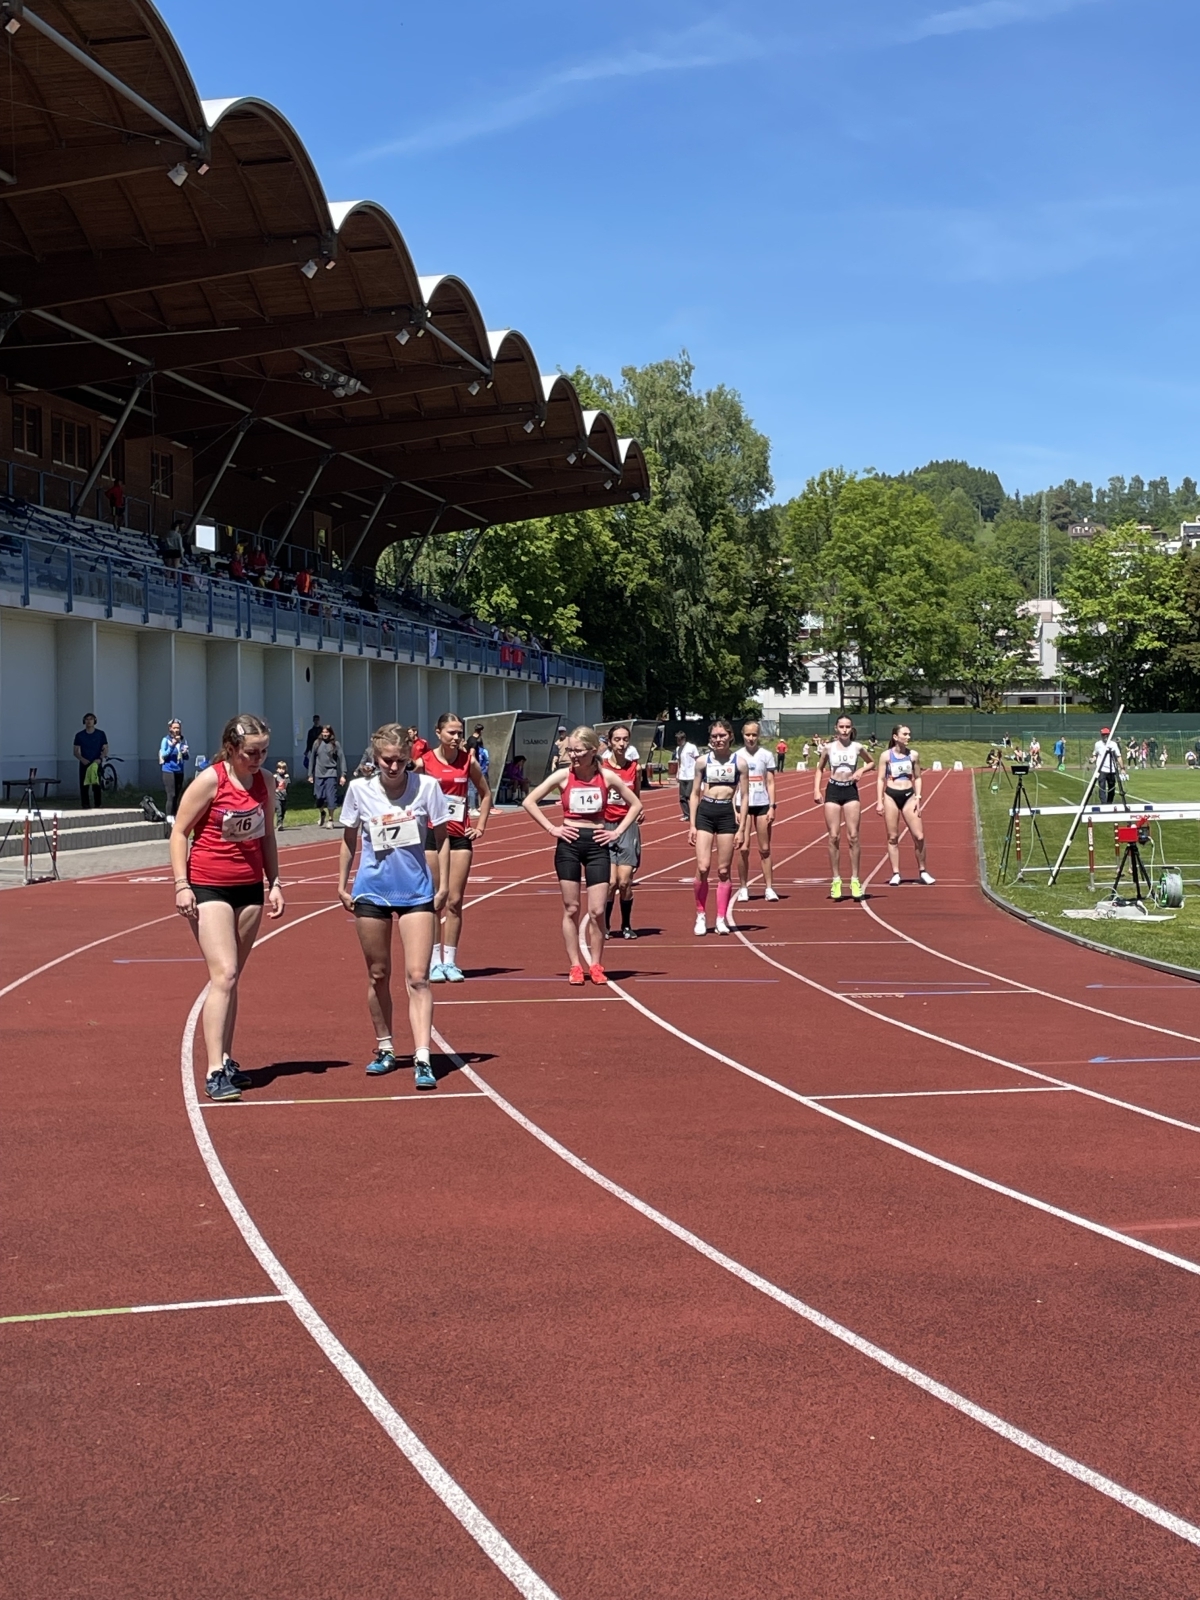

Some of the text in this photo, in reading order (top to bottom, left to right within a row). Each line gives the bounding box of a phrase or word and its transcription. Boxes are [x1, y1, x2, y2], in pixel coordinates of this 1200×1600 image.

[715, 769, 727, 777] 12
[580, 796, 593, 805] 14
[448, 804, 456, 814] 5
[235, 817, 252, 832] 16
[377, 825, 401, 842] 17
